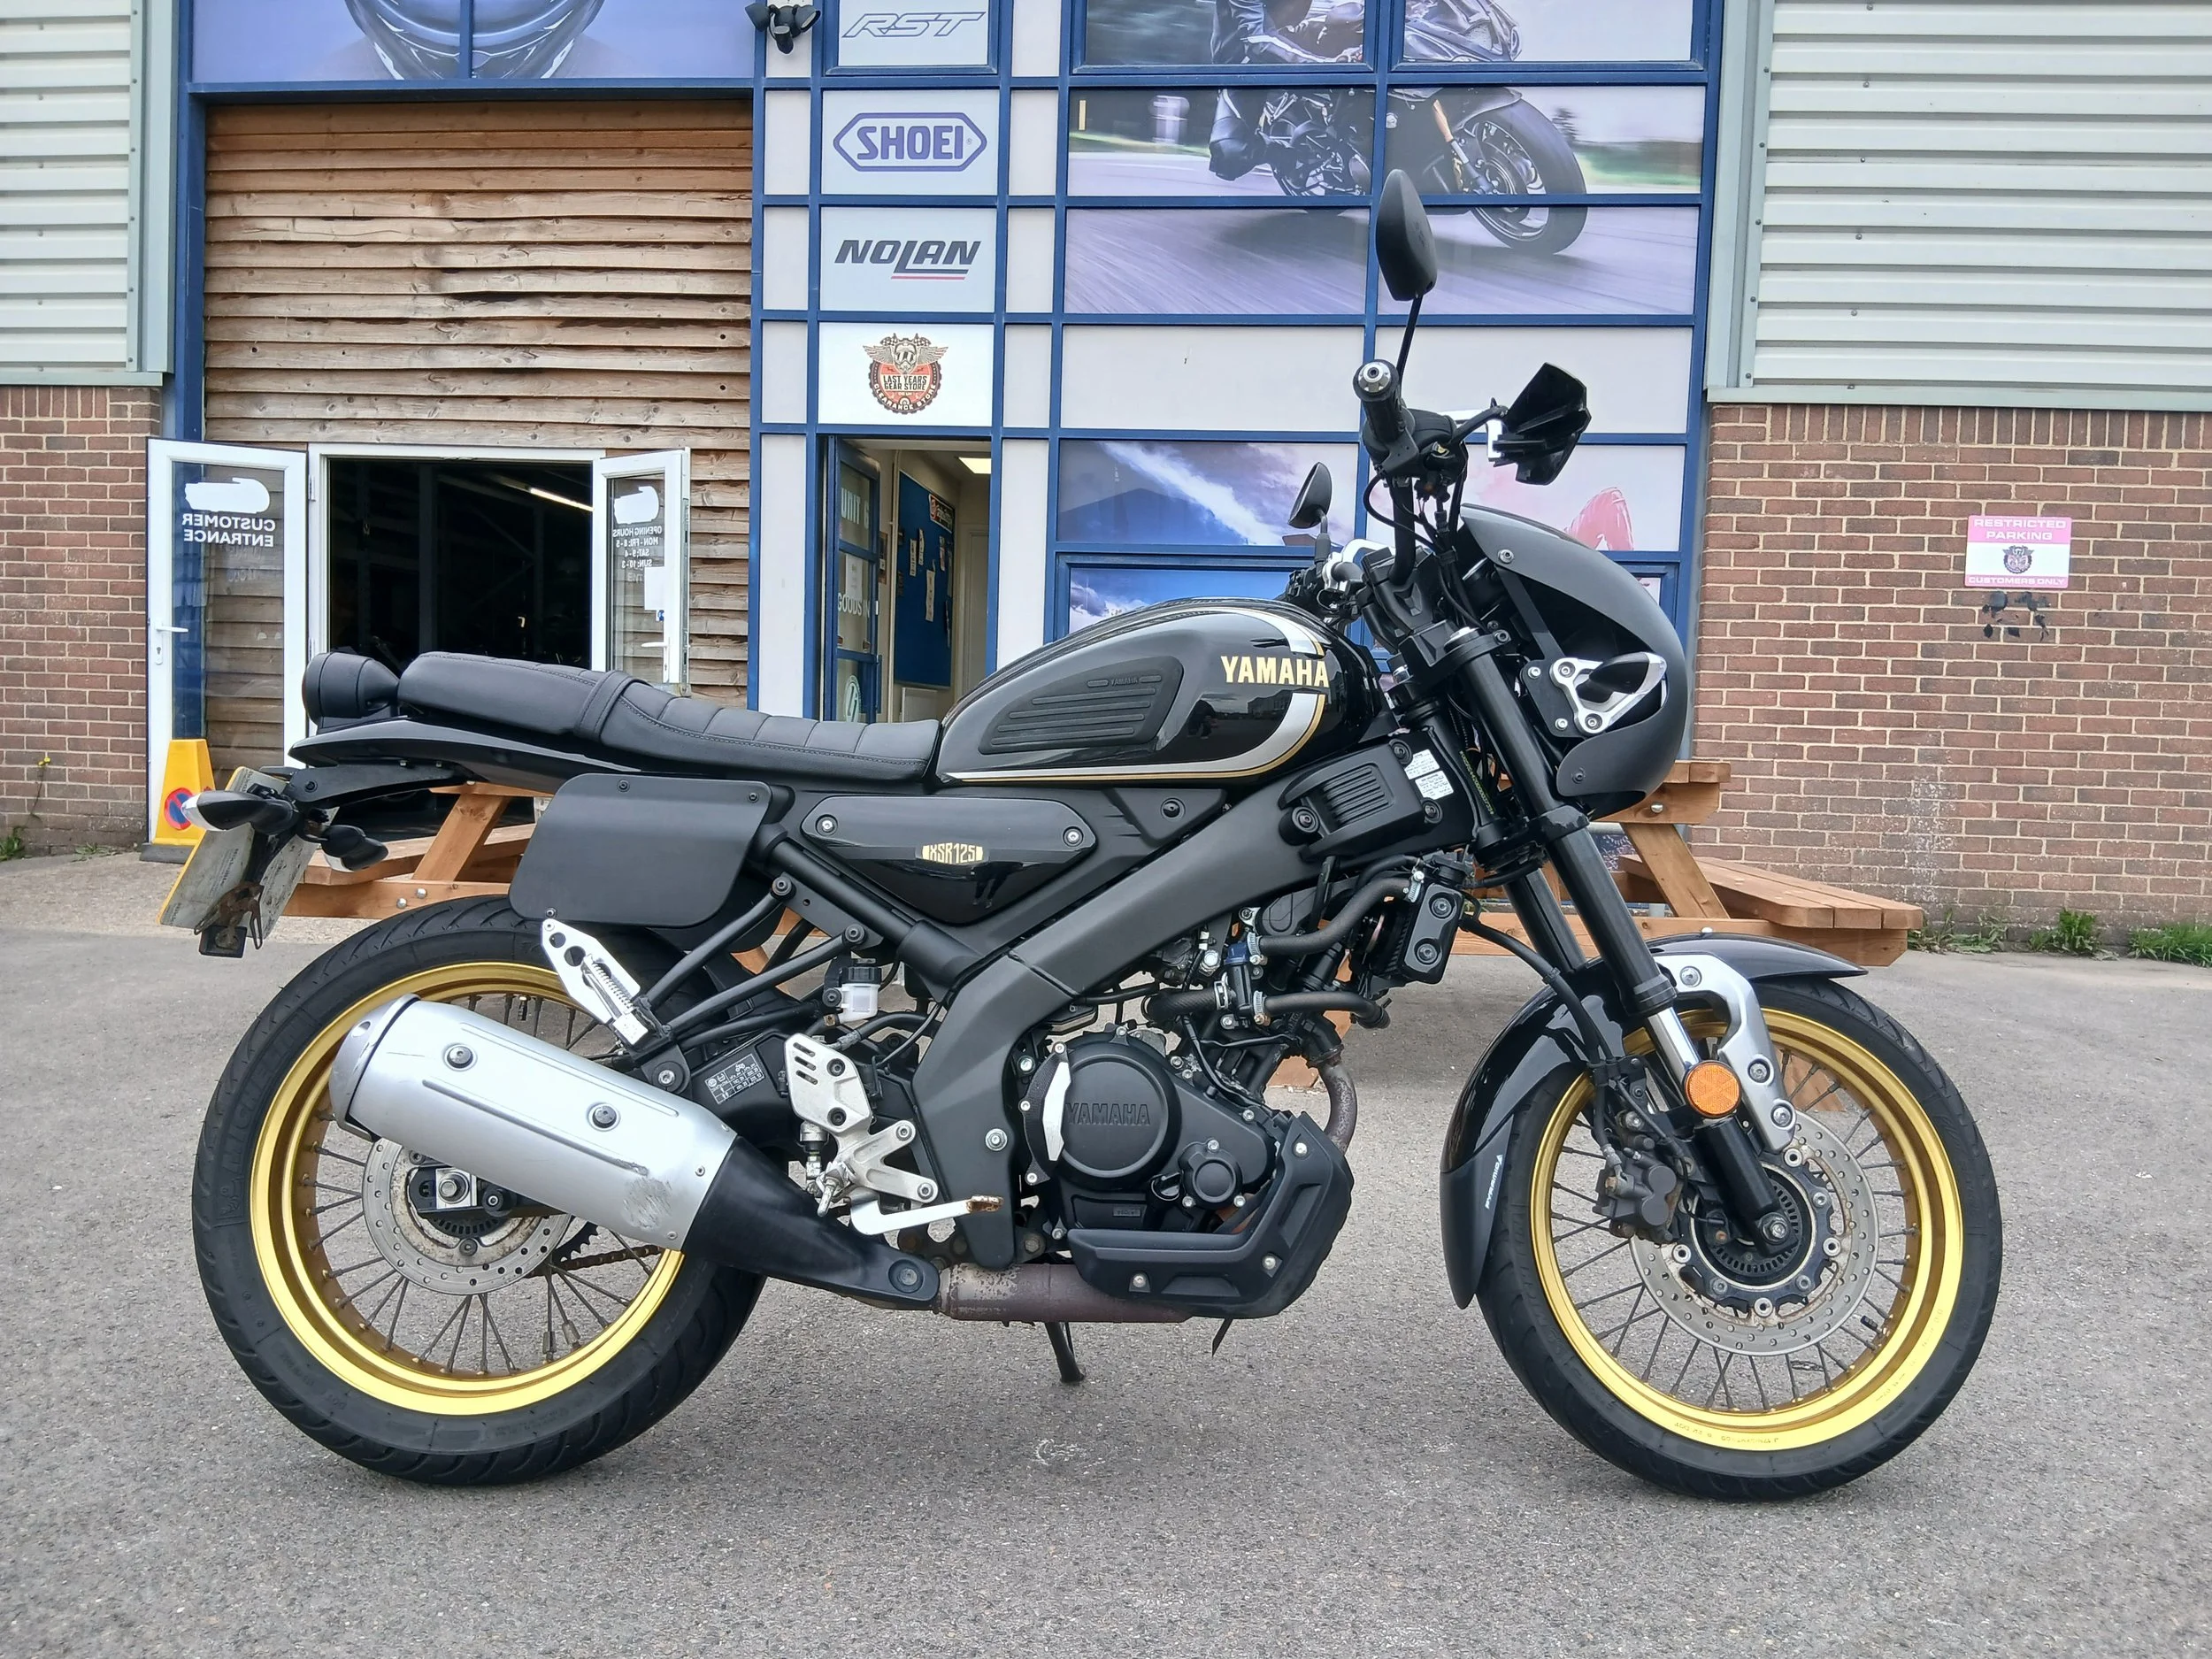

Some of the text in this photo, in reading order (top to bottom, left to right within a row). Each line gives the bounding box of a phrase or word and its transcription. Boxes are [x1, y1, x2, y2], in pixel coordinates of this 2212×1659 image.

[841, 12, 986, 38] RST
[856, 125, 964, 160] SHOEI
[834, 239, 981, 273] NOLAN
[874, 383, 936, 411] CLEARANCE STORE
[1974, 518, 2066, 529] RESTRICTED
[1985, 531, 2053, 541] PARKING
[837, 592, 863, 617] GOODS
[1220, 655, 1330, 688] YAMAHA
[930, 842, 975, 864] XSR125
[1065, 1102, 1150, 1125] YAMAHA
